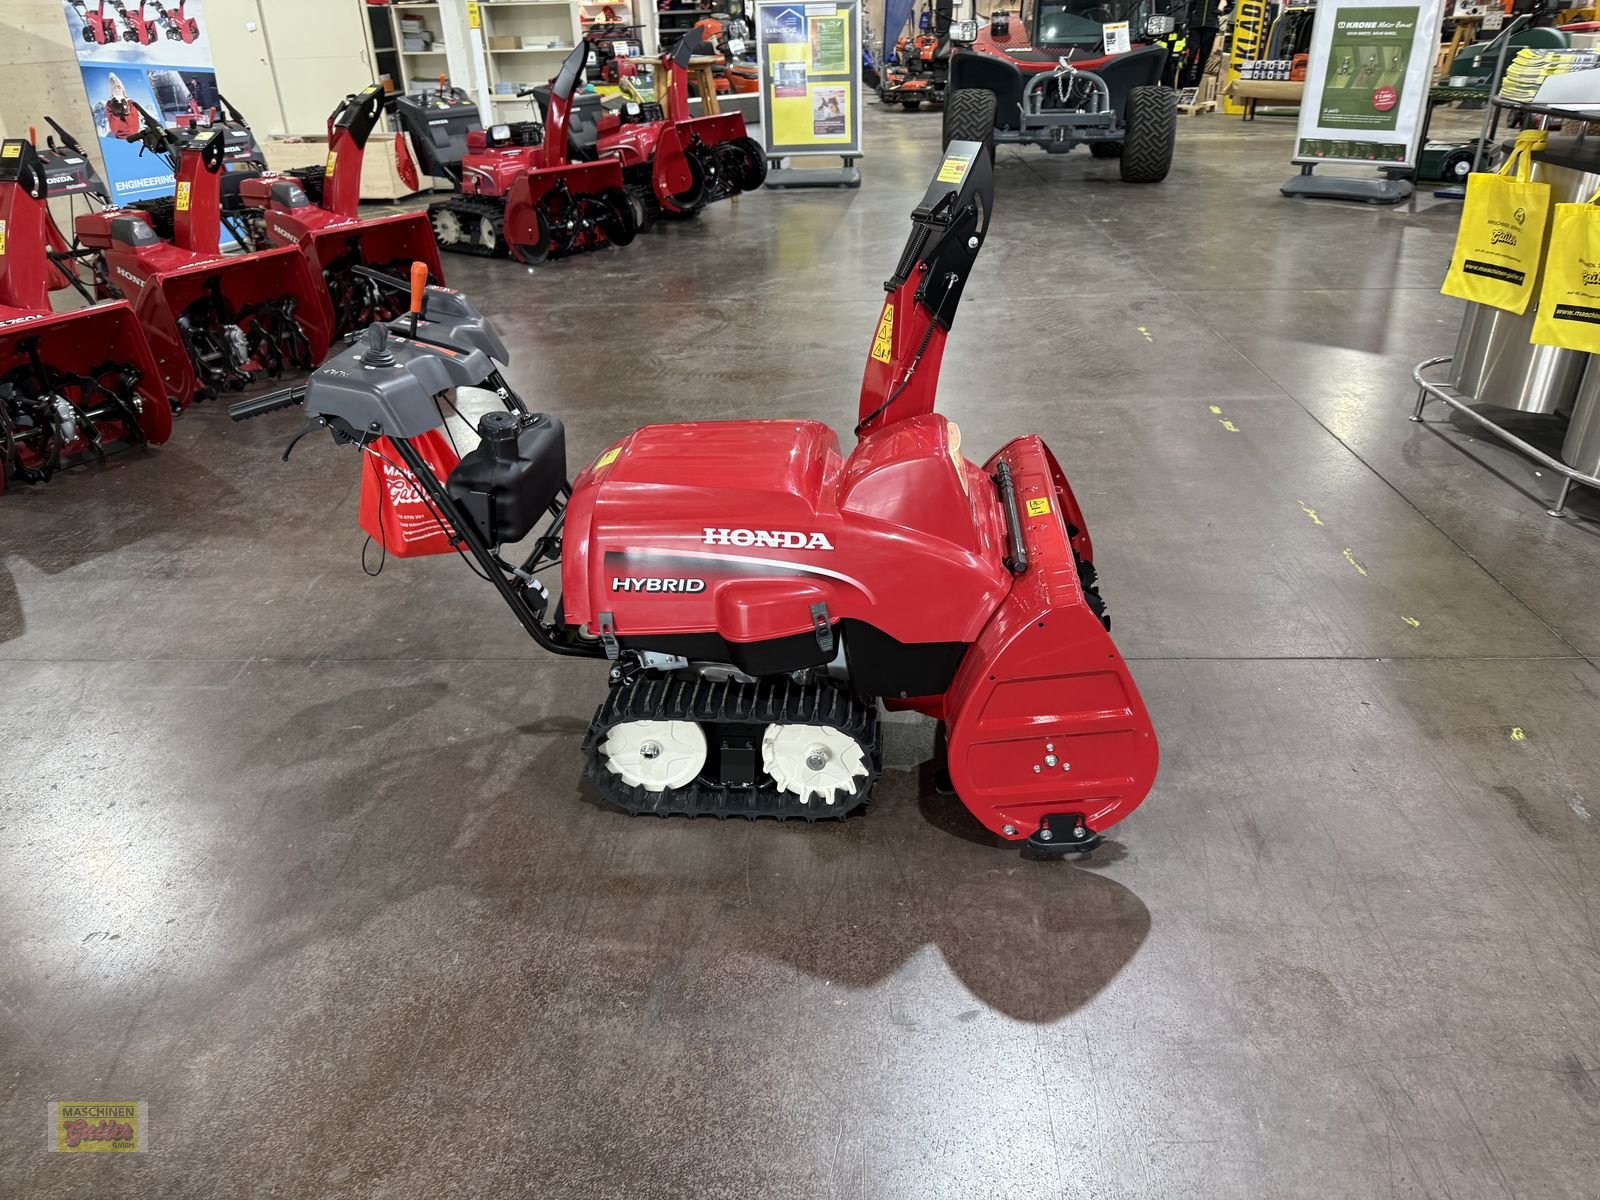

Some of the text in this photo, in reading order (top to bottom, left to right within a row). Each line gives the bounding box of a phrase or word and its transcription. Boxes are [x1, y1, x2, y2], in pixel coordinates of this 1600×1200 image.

[1345, 21, 1378, 29] KRONE
[46, 175, 74, 184] ONDA
[115, 174, 176, 191] ENGINEERING
[273, 224, 300, 244] HOND
[116, 266, 146, 287] HON
[703, 528, 834, 550] HONDA
[612, 577, 706, 593] HYBRID
